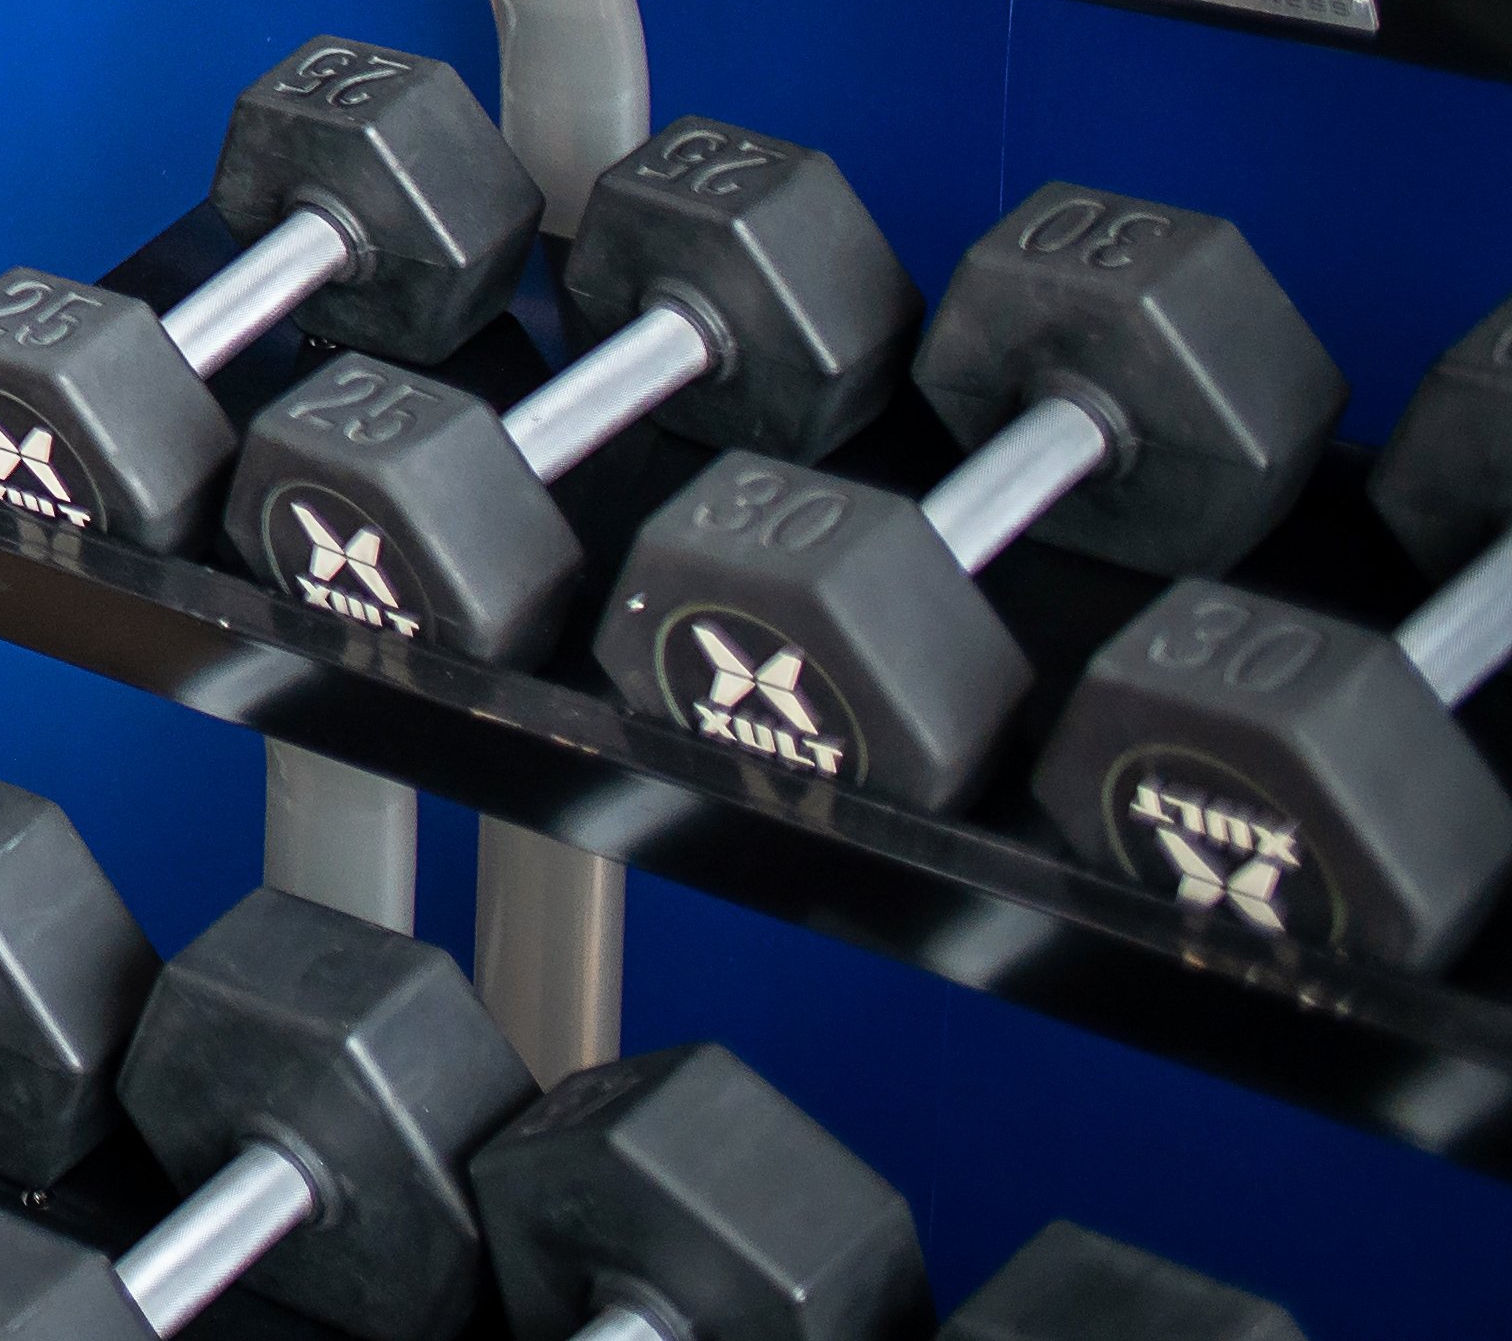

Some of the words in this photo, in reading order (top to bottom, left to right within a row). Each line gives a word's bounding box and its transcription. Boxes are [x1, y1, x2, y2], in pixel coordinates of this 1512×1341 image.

[275, 46, 416, 108] 25
[636, 127, 788, 197] 25
[1017, 196, 1175, 271] 30
[288, 363, 441, 445] 25
[693, 469, 853, 553] 30
[1147, 600, 1326, 693] 30
[693, 701, 844, 776] XULT
[1128, 783, 1302, 869] XULT
